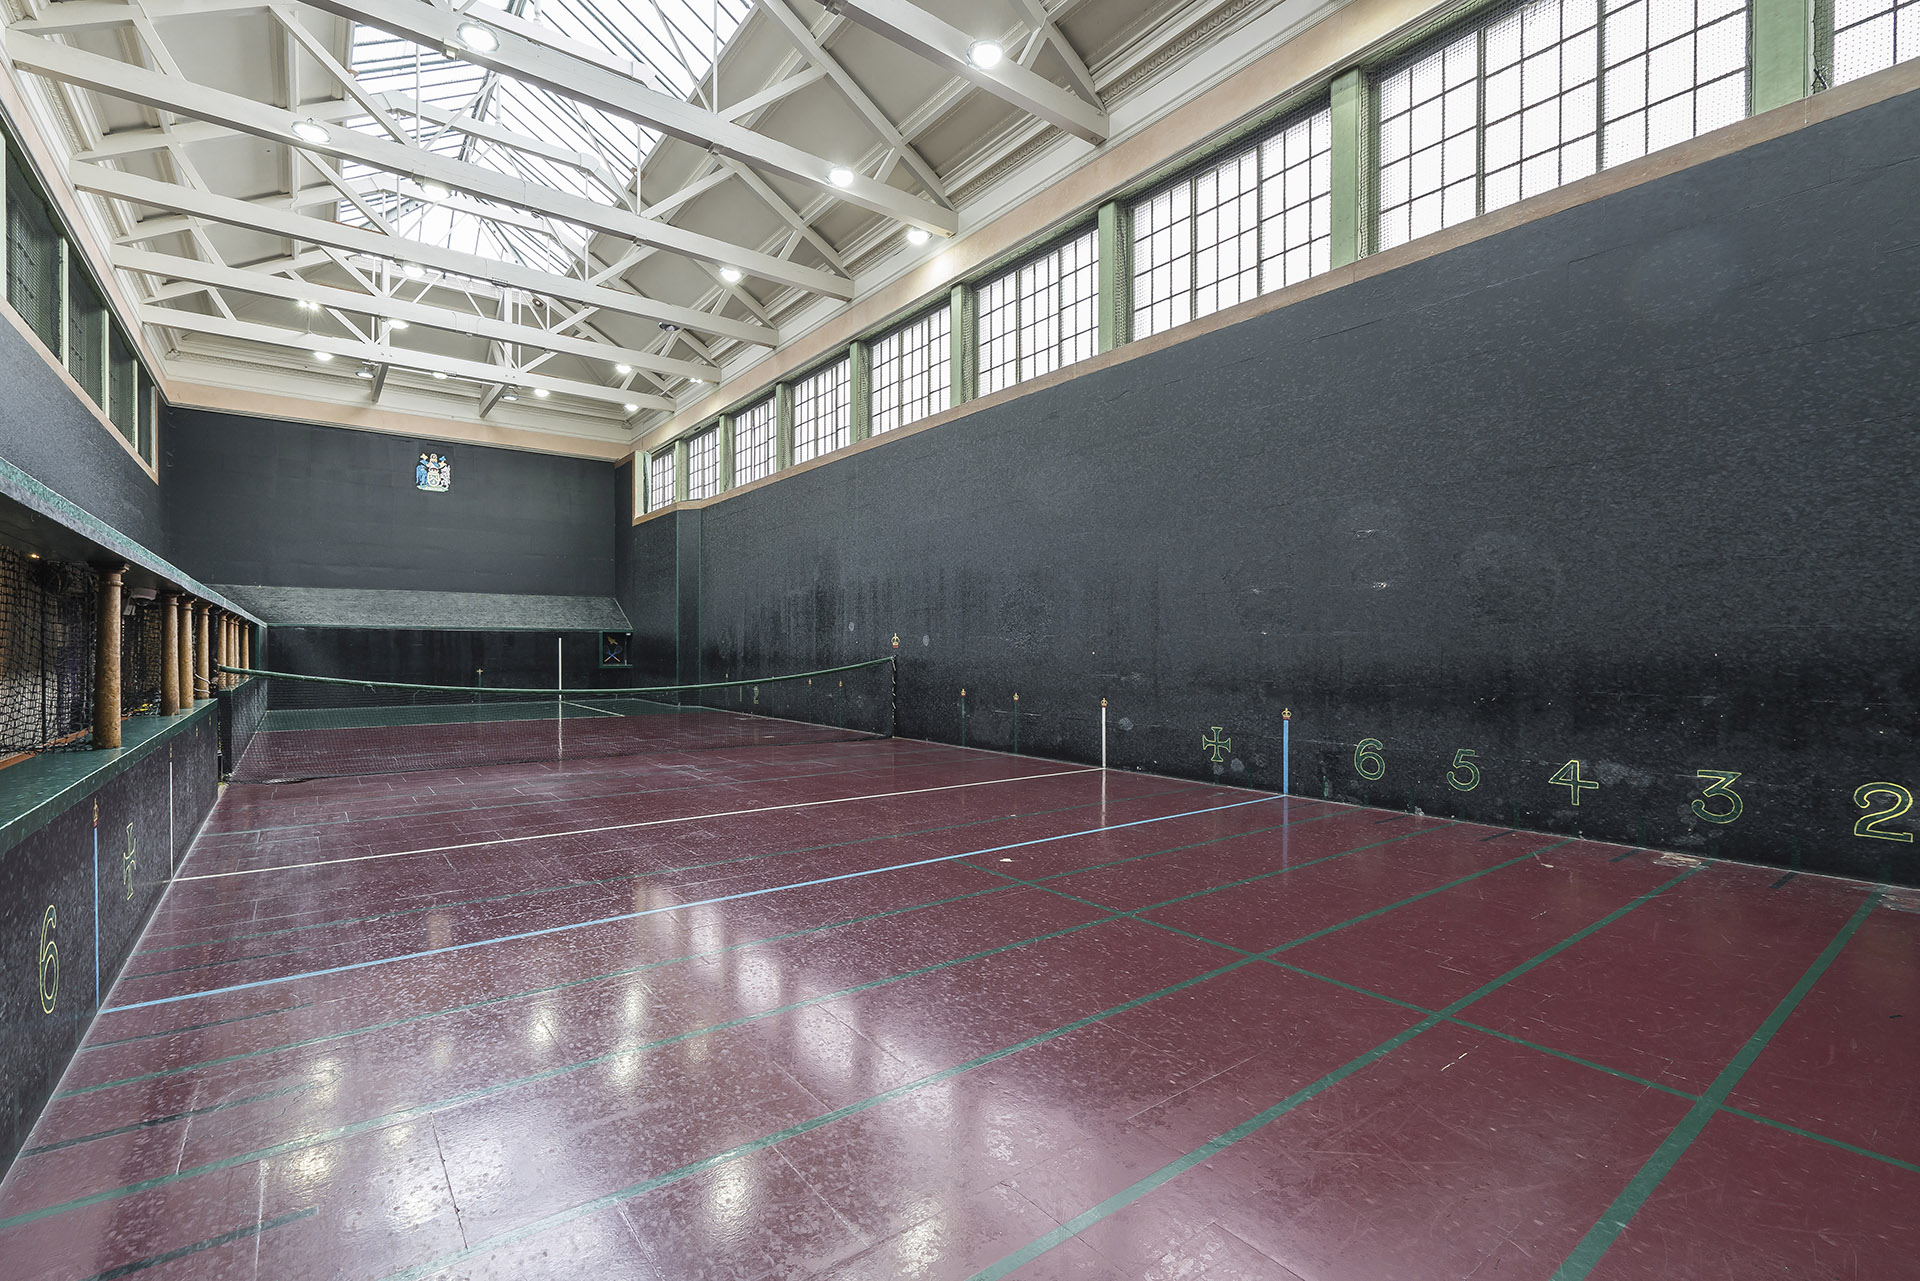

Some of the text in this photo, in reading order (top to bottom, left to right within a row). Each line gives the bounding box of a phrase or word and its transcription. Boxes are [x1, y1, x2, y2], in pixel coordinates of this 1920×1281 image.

[1354, 738, 1385, 781] 6
[1447, 749, 1480, 792] 5
[1548, 760, 1599, 806] 4
[1691, 770, 1743, 824] 3
[1853, 781, 1914, 843] 2
[39, 904, 60, 1015] 6
